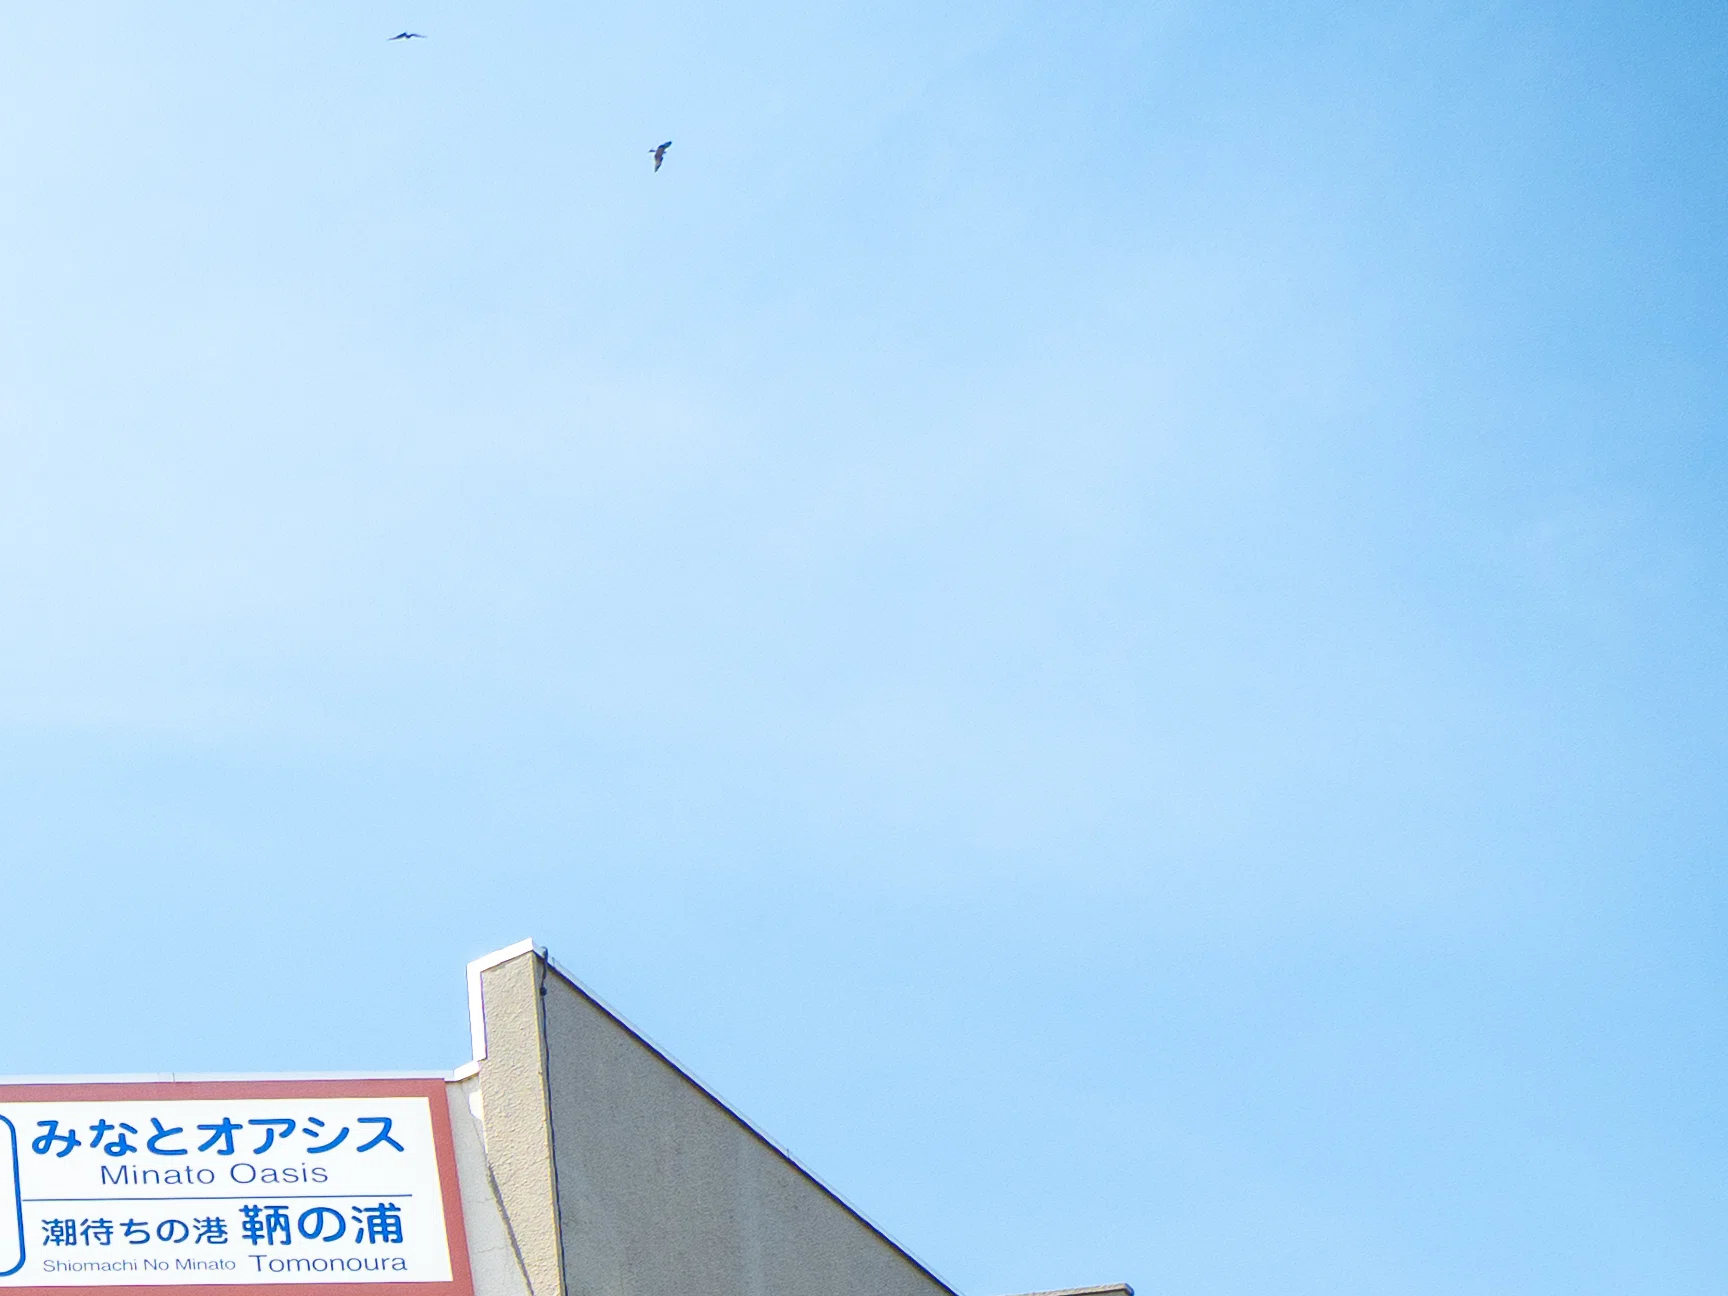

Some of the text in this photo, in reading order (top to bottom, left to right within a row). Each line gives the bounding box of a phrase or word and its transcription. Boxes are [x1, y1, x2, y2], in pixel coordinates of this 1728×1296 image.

[31, 1115, 405, 1160] みなとオアシス
[99, 1161, 329, 1187] Minato Oasis
[41, 1202, 403, 1247] 潮待ちの港 鞆の浦
[42, 1253, 408, 1274] Shiomachi No Minato Tomonoura
